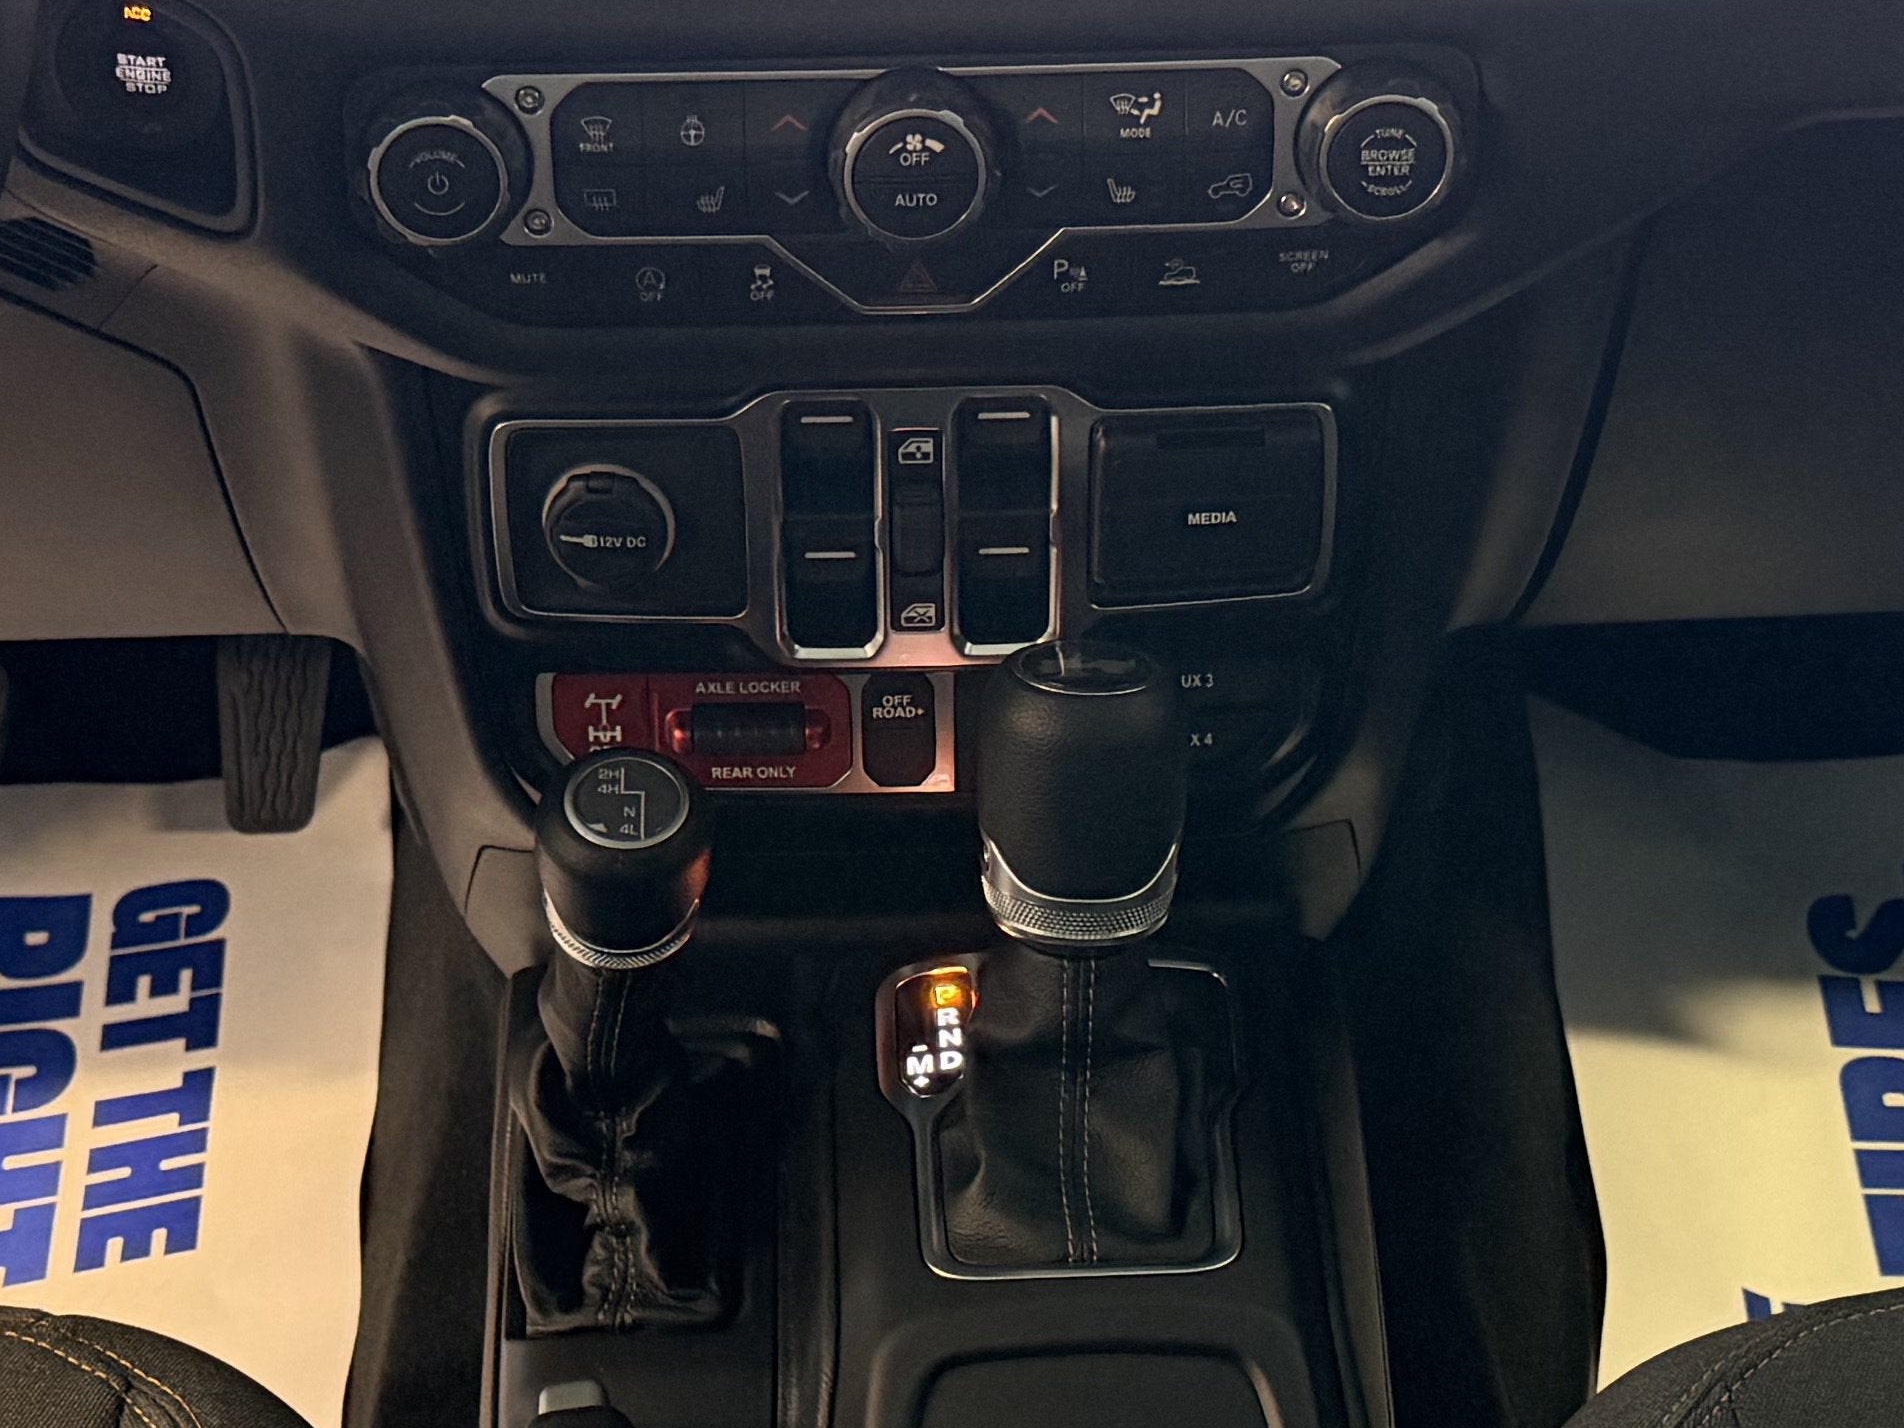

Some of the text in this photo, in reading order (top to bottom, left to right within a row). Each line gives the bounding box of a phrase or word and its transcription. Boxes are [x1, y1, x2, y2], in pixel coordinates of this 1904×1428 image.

[116, 53, 166, 67] START
[115, 67, 172, 82] ENGINE
[125, 82, 168, 95] STOP
[1212, 109, 1247, 127] A/C
[1120, 128, 1152, 139] MODE
[579, 142, 615, 153] FRONT
[415, 150, 458, 164] VOLUME
[900, 152, 930, 167] OFF
[1361, 148, 1415, 162] BROWSE
[1368, 165, 1410, 176] ENTER
[895, 193, 938, 207] AUTO
[1279, 249, 1329, 261] SCREEN
[1290, 262, 1314, 274] OFF
[510, 273, 547, 284] MUTE
[1061, 282, 1085, 293] OFF
[639, 290, 663, 302] OFF
[749, 290, 775, 301] OFF
[1187, 511, 1237, 526] MEDIA
[599, 536, 647, 548] 12V DC
[696, 681, 801, 694] AXLE LOCKER
[1181, 674, 1214, 688] UX 3
[881, 694, 912, 707] OFF
[872, 705, 925, 719] ROAD+
[1203, 733, 1213, 747] 4
[598, 768, 619, 780] 2H
[711, 765, 796, 779] REAR ONLY
[597, 782, 620, 794] 4H
[623, 806, 636, 817] N
[619, 823, 637, 835] 4L
[935, 984, 957, 1005] P
[937, 1007, 959, 1026] R
[939, 1029, 963, 1046] N
[906, 1054, 934, 1075] M
[939, 1051, 964, 1070] D
[72, 878, 230, 1274] GET THE
